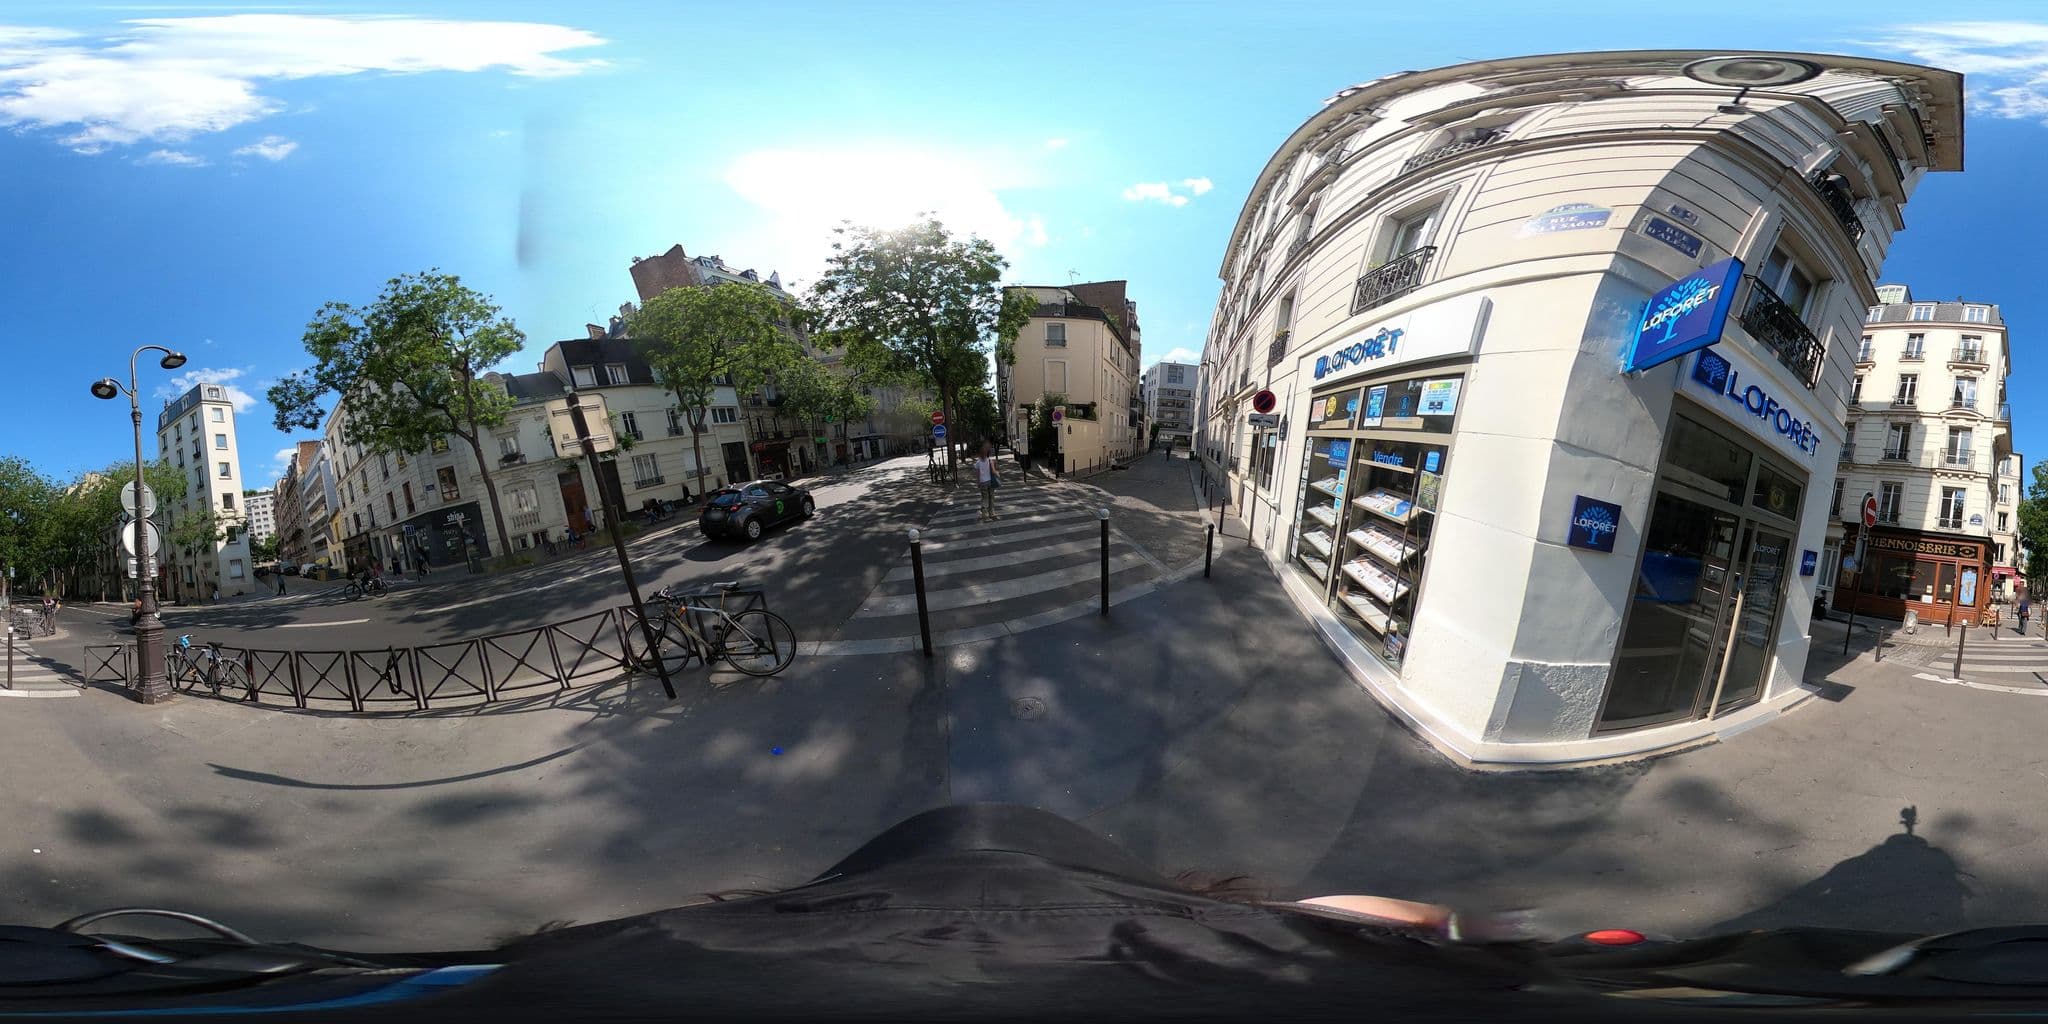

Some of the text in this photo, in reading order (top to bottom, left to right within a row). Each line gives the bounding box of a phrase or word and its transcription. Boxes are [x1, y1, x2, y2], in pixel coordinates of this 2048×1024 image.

[1550, 216, 1578, 224] RUE
[1374, 450, 1404, 466] Vendre
[1868, 535, 1957, 556] VIENNOISERIE
